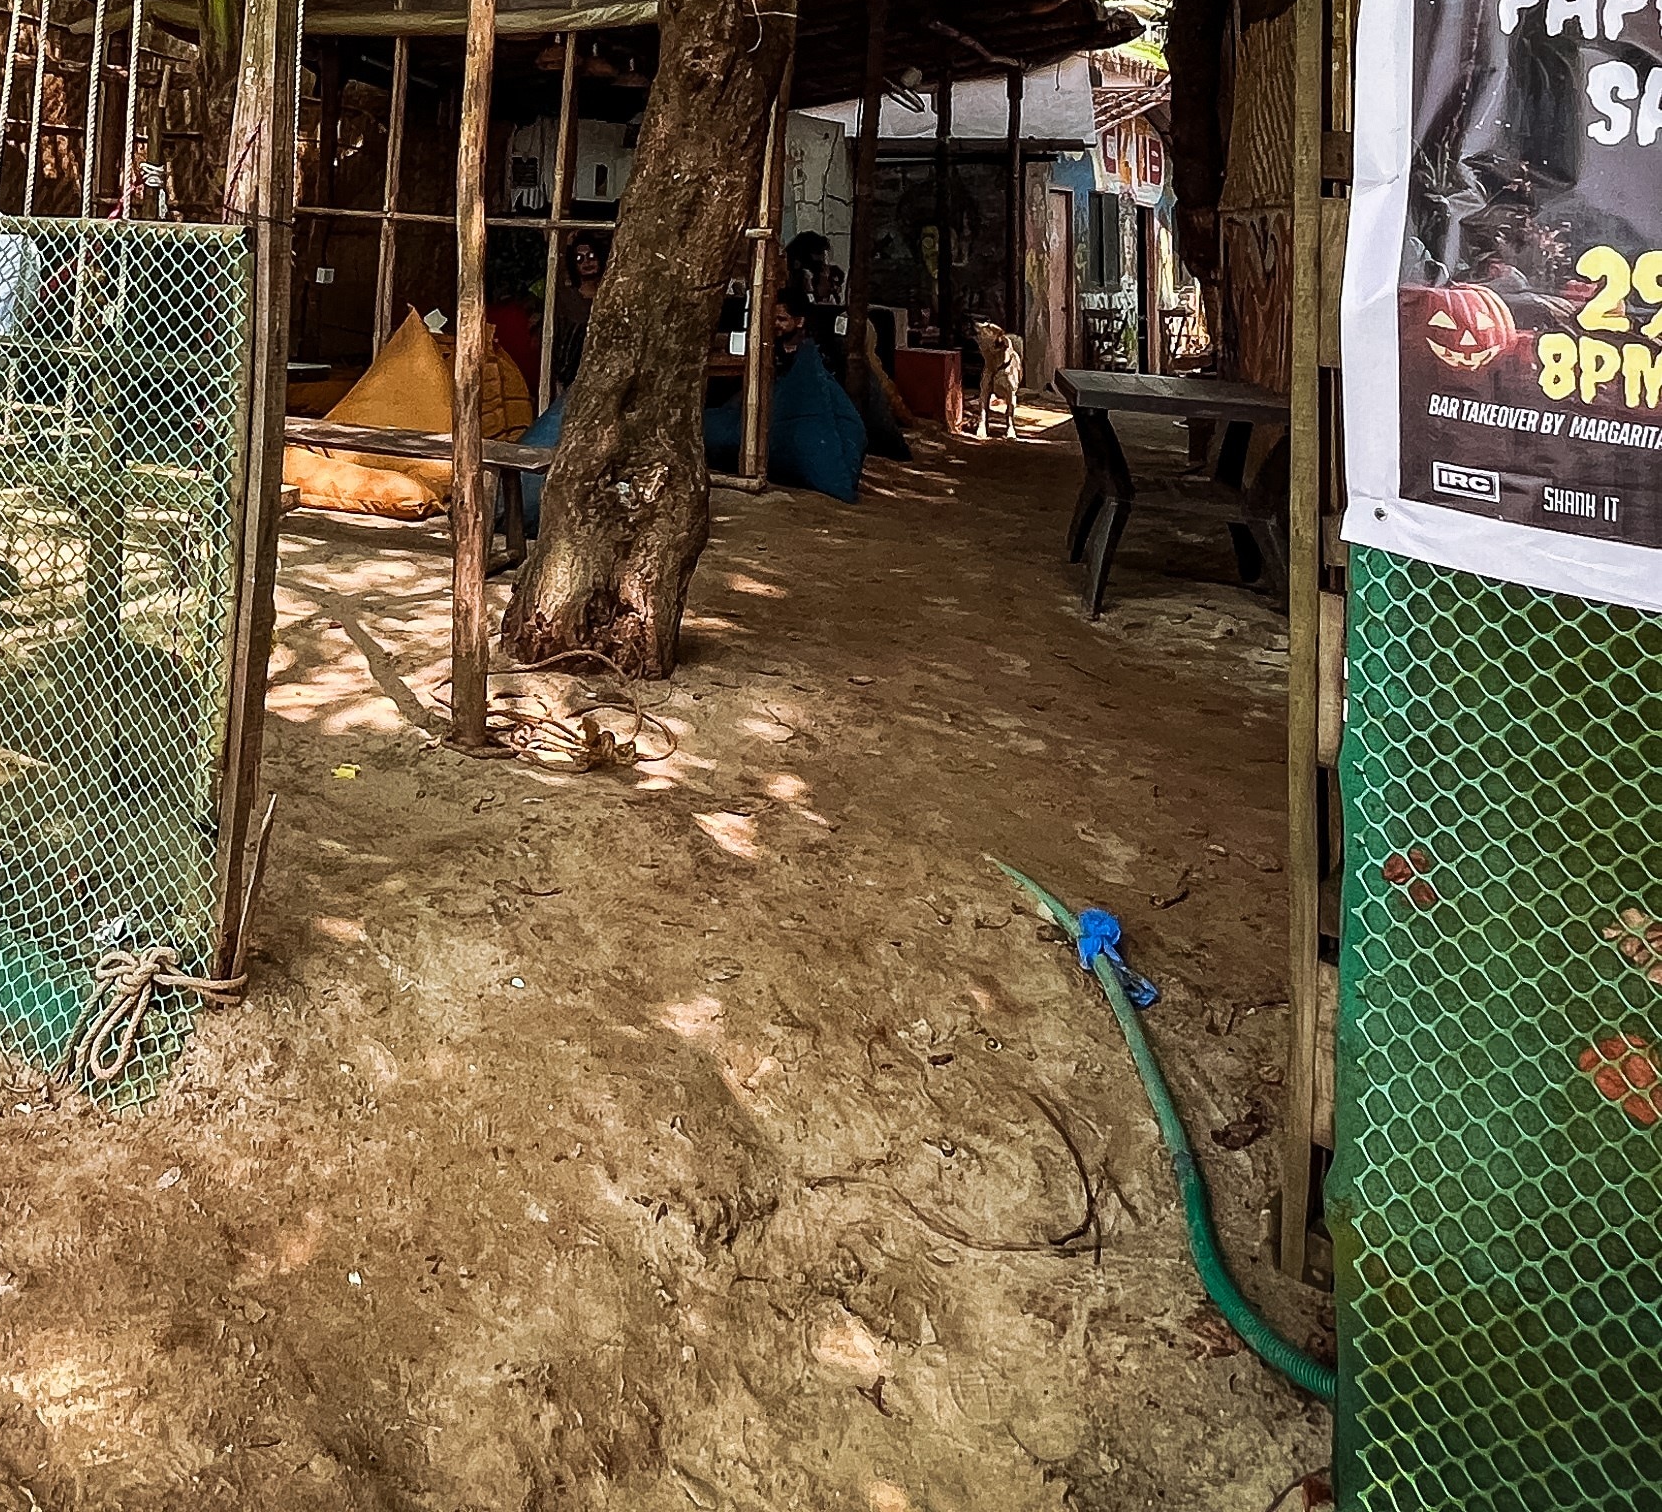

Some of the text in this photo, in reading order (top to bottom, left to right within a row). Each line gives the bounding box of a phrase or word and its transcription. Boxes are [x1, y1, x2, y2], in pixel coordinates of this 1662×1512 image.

[1538, 332, 1662, 409] 8PM
[1428, 394, 1460, 420] BAR
[1462, 399, 1539, 432] TAKEOVER
[1540, 410, 1566, 436] BY
[1440, 470, 1492, 493] IRC
[1543, 486, 1620, 522] SHANK IT
